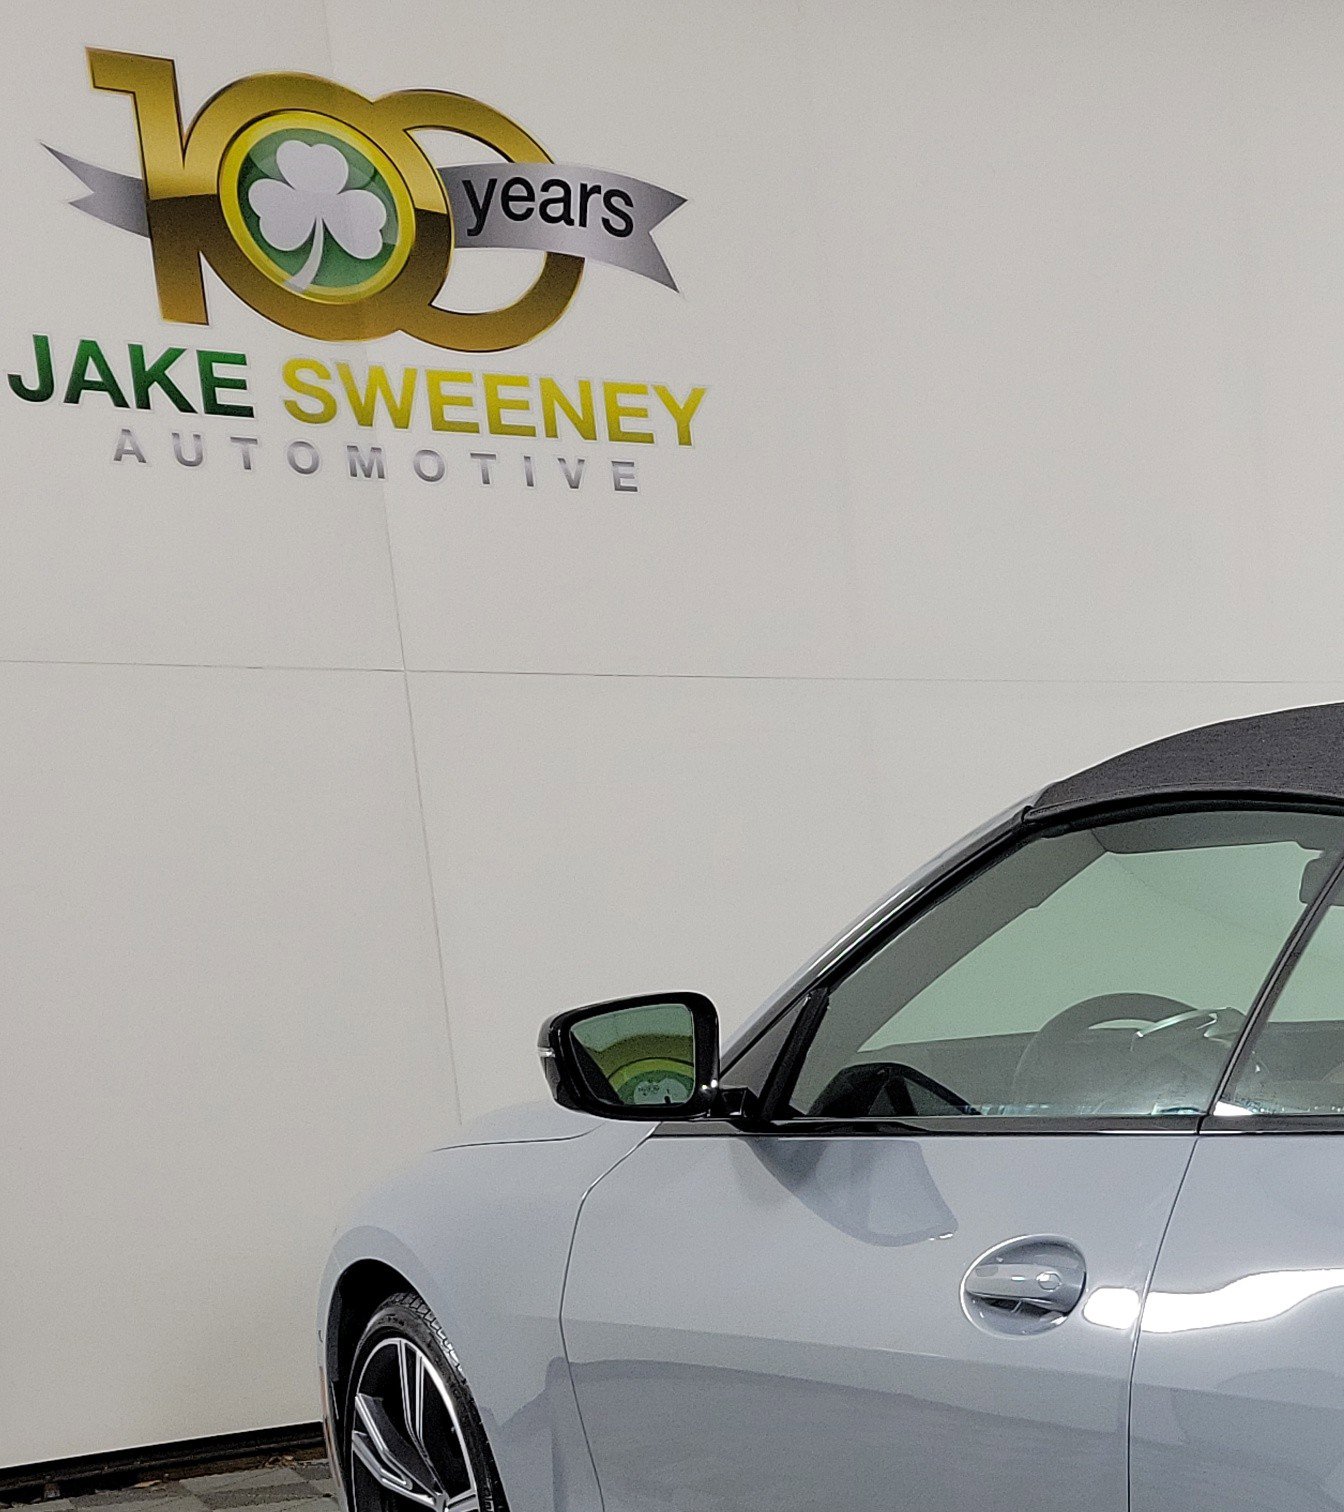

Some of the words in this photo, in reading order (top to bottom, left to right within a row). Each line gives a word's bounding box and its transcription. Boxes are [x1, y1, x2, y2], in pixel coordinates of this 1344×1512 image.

[86, 46, 585, 352] 100
[461, 172, 635, 238] years
[7, 334, 256, 418] JAKE
[281, 357, 709, 447] SWEENEY
[112, 428, 640, 492] AUTOMOTIVE
